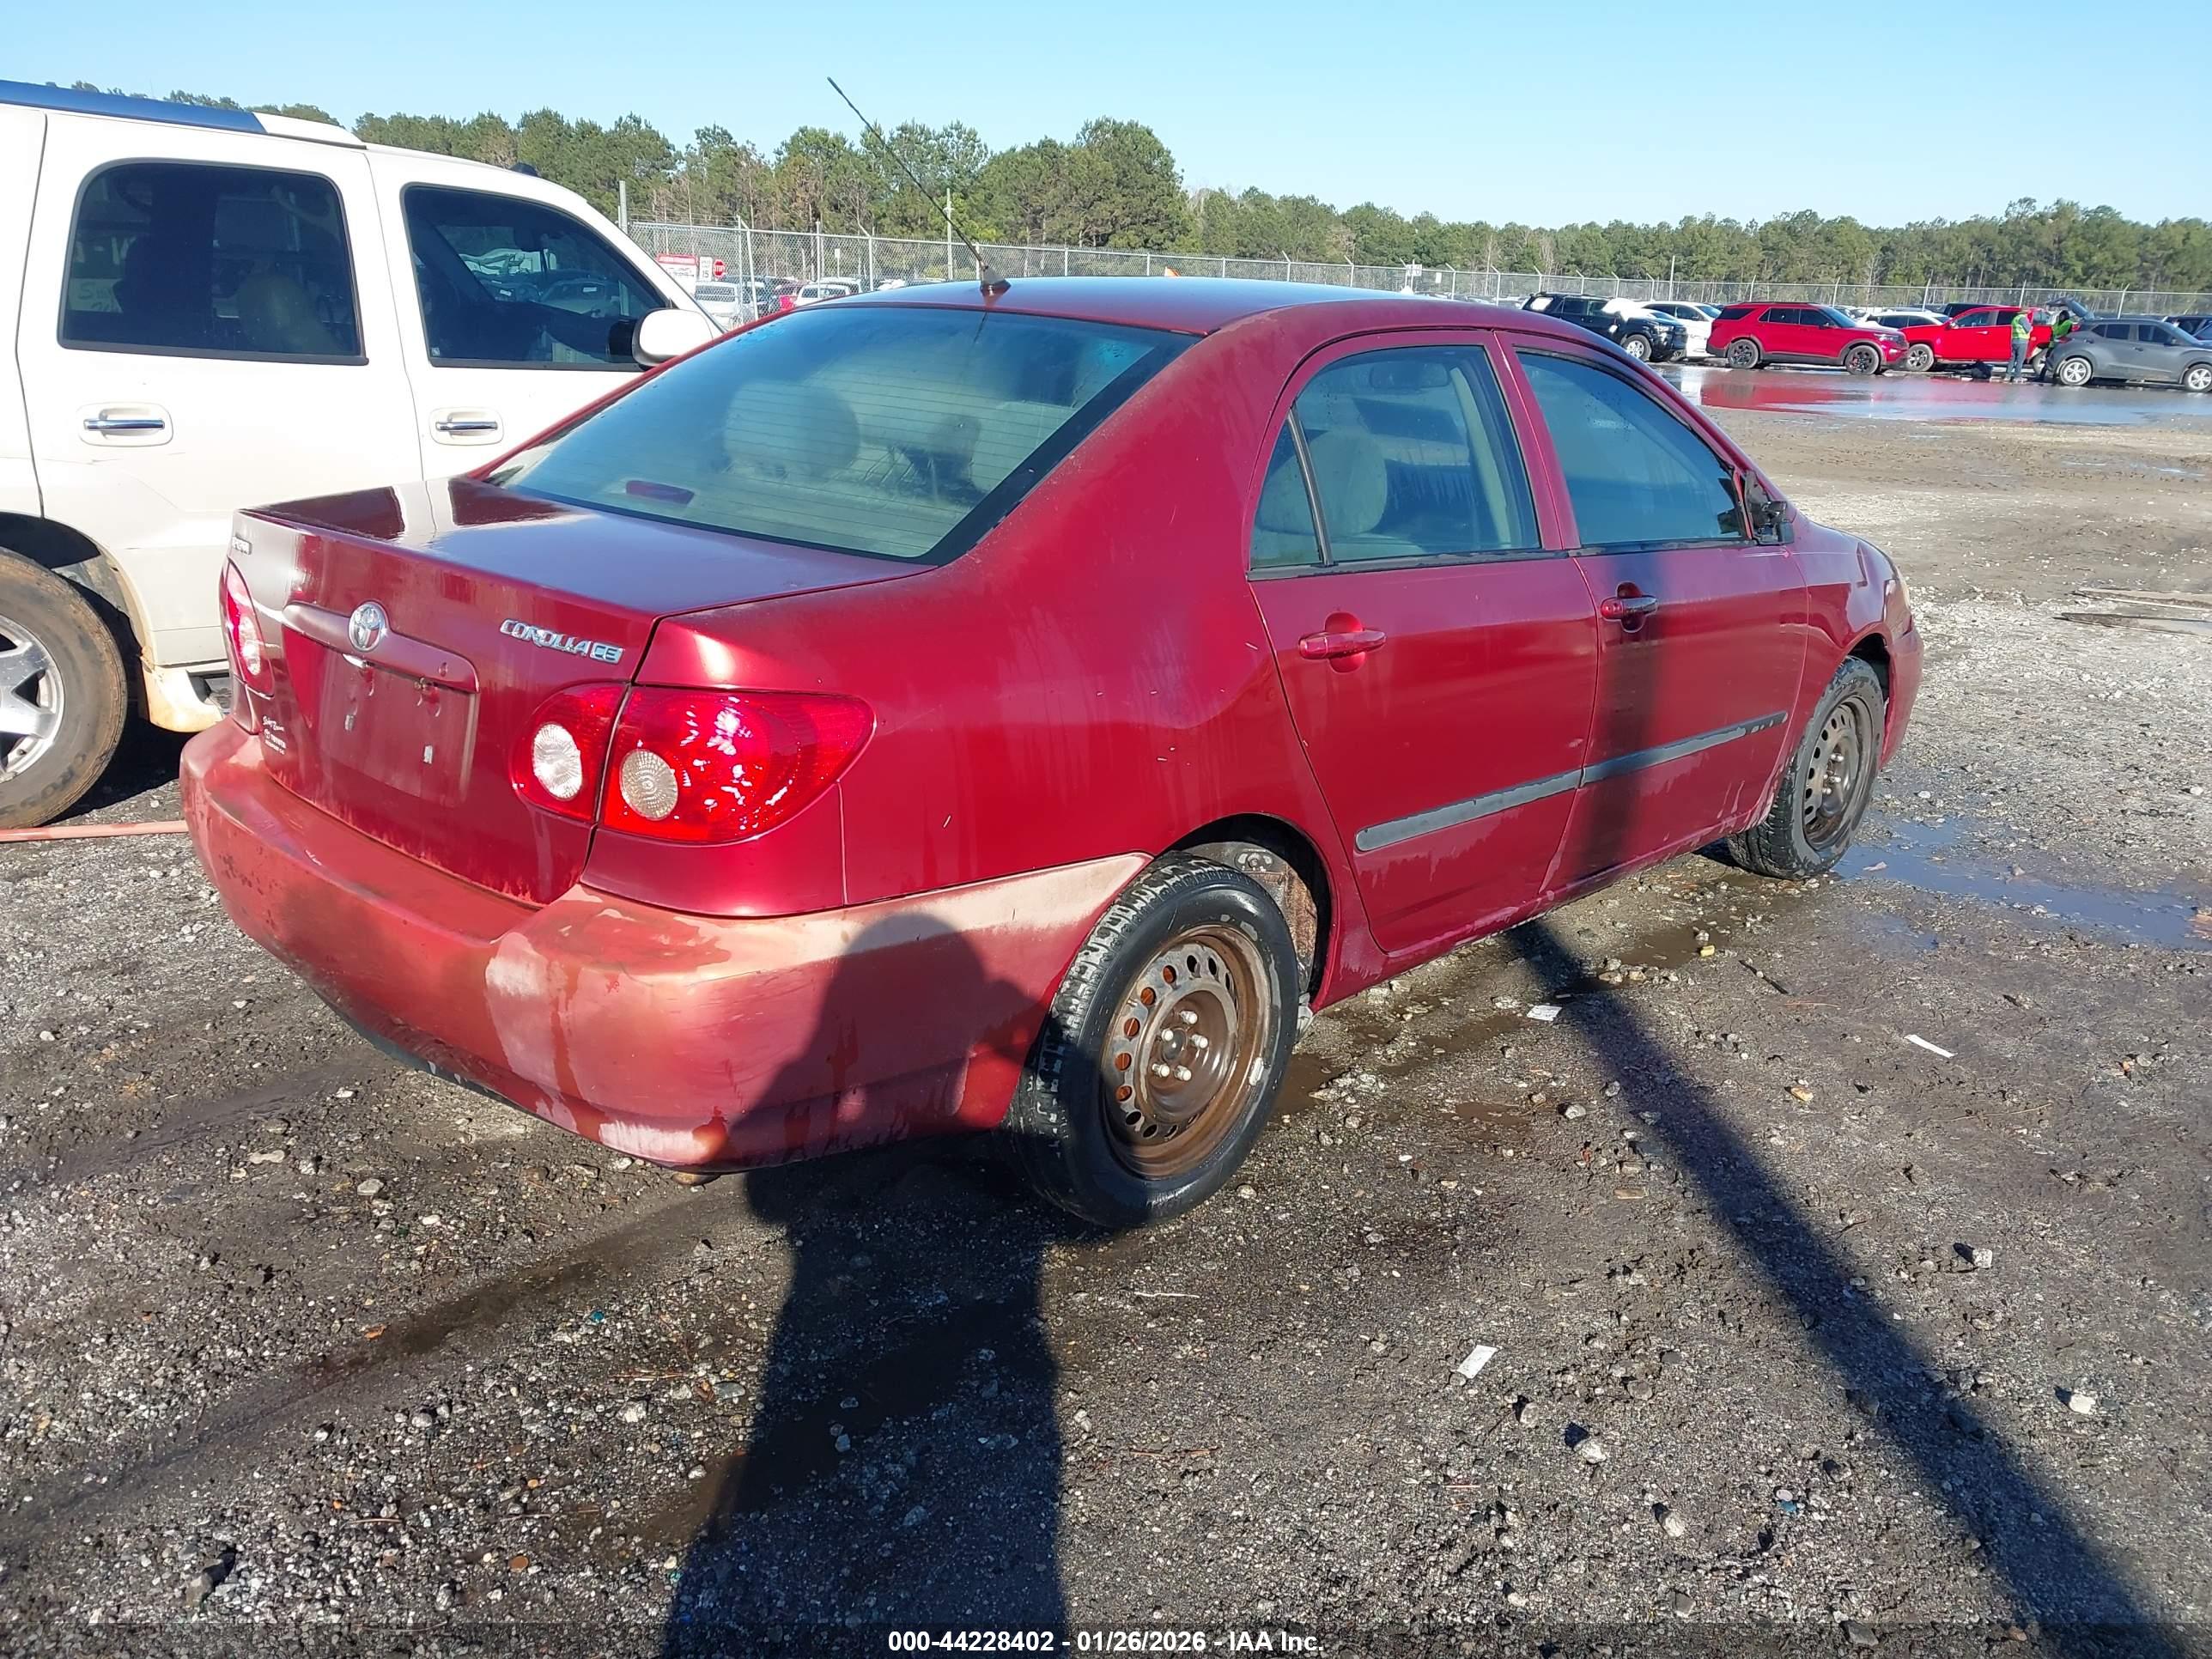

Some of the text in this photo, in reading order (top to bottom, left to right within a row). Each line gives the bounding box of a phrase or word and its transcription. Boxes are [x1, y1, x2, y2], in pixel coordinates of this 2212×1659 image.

[702, 270, 709, 278] 15
[500, 618, 621, 662] COROLLA CE
